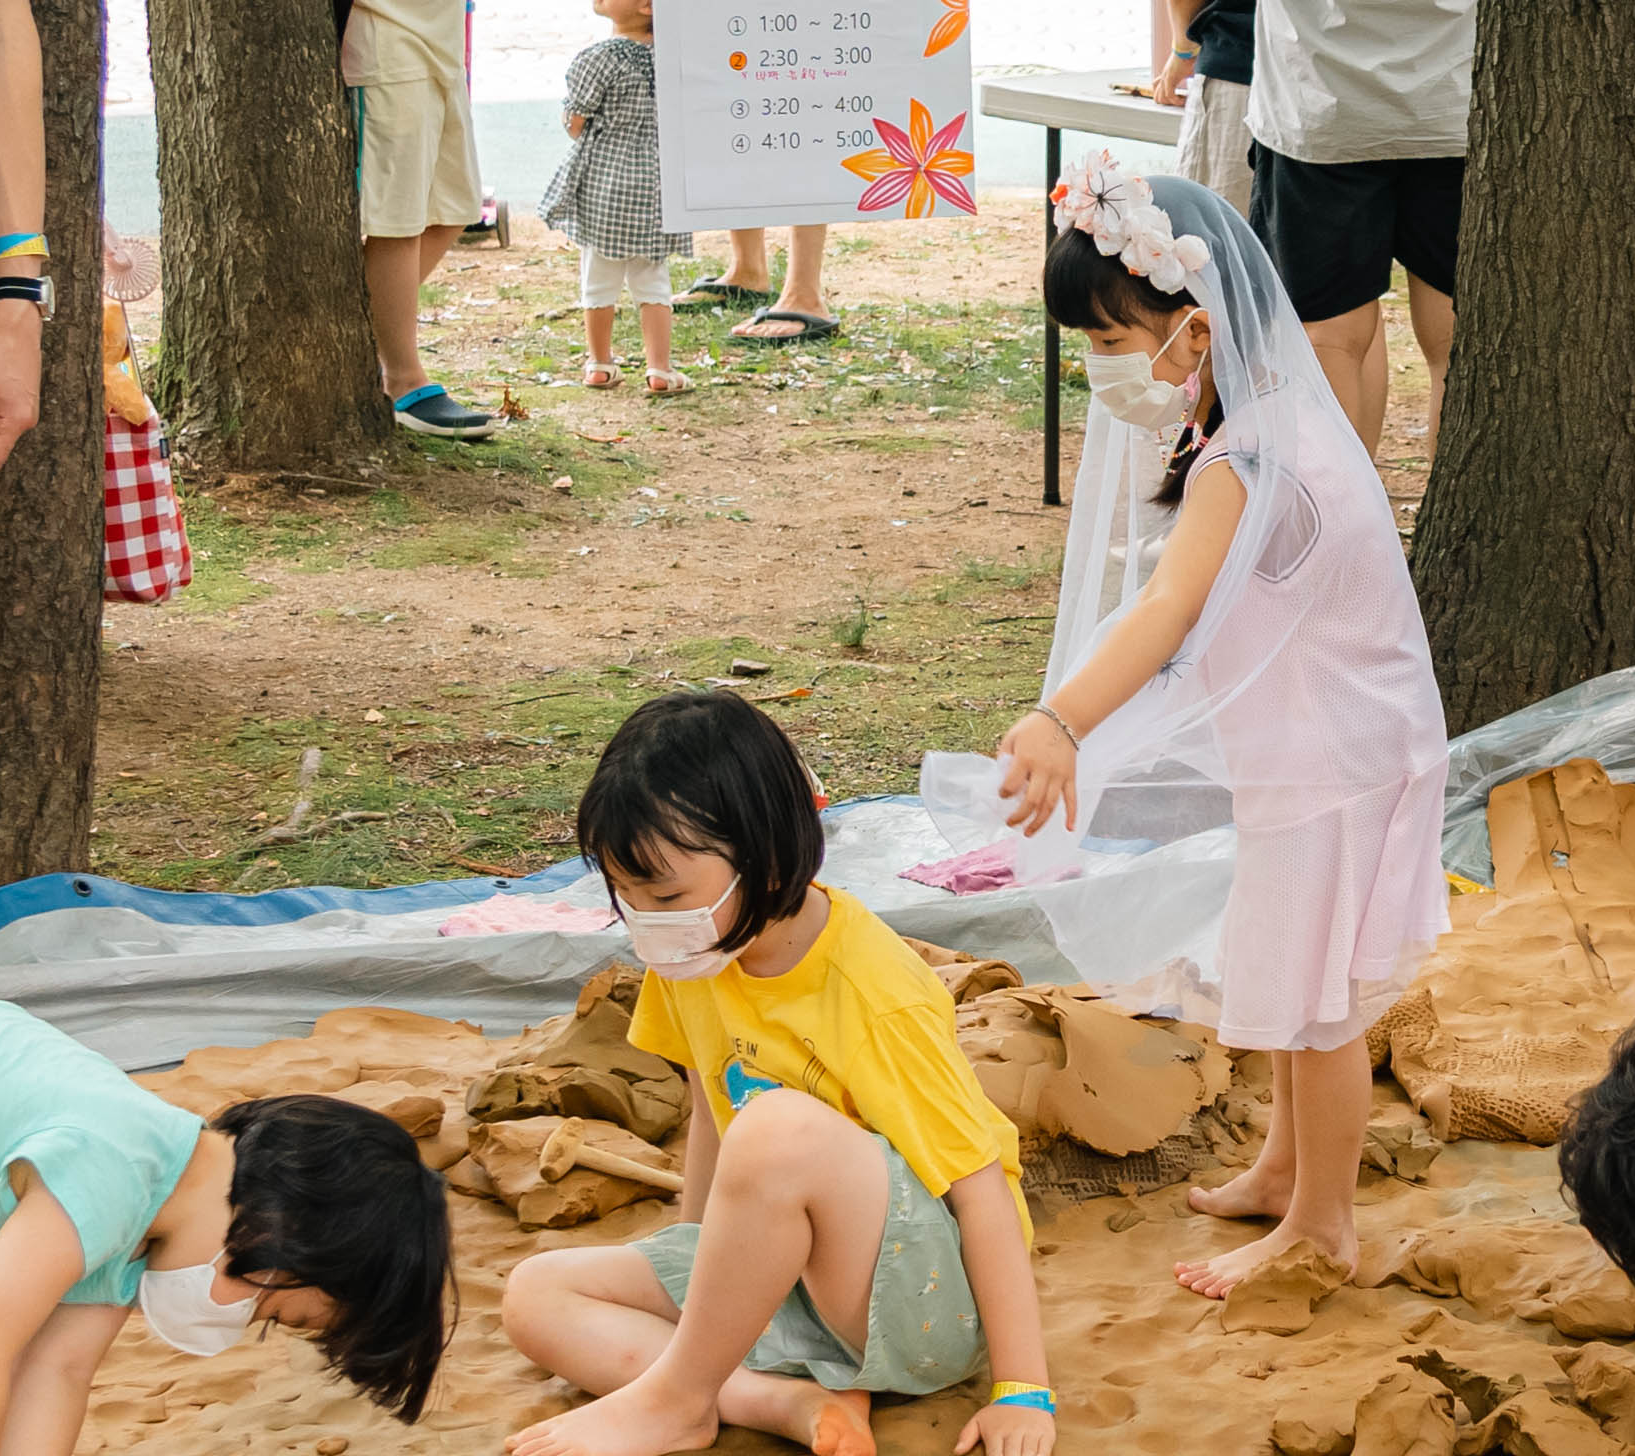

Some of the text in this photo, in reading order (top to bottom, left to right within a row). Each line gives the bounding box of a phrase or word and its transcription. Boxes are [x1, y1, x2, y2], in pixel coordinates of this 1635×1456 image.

[759, 14, 798, 32] 1:00
[832, 12, 871, 31] 2:10
[759, 48, 799, 67] 2:30
[834, 46, 872, 65] 3:00
[761, 97, 800, 116] 3:20
[834, 95, 873, 113] 4:00
[761, 131, 801, 150] 4:10
[836, 129, 874, 148] 5:00
